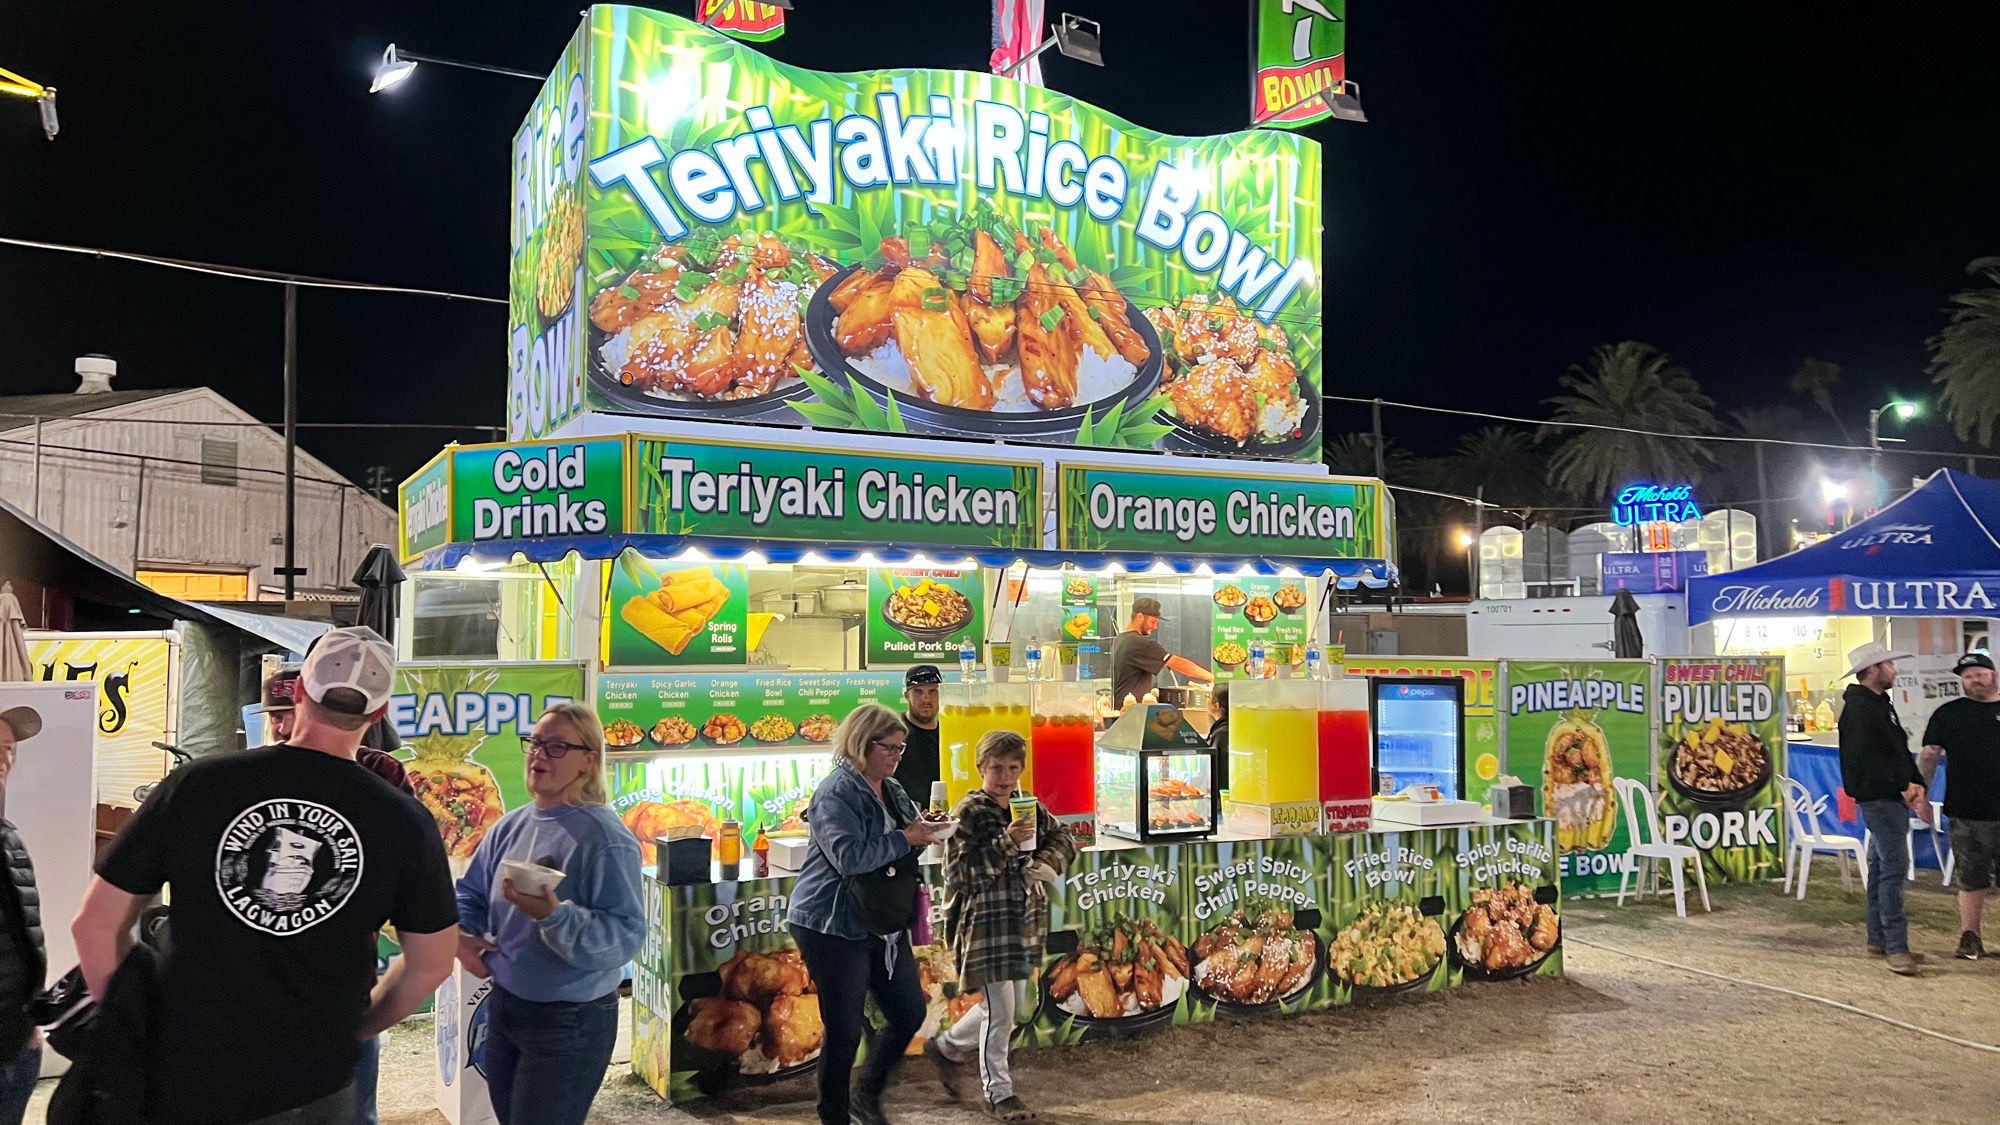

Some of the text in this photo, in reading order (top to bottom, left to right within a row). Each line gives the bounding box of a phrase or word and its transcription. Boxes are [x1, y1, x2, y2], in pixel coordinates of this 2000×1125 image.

[515, 73, 585, 254] Rice
[589, 92, 1310, 326] Teriyaki Rice Bowl
[493, 445, 586, 495] Cold
[660, 456, 1018, 527] Teriyaki Chicken
[473, 493, 607, 540] Drinks
[1089, 482, 1356, 542] Orange Chicken
[1612, 502, 1703, 526] ULTRA
[1841, 532, 1935, 549] ULTRA
[1603, 565, 1640, 575] ULTRA
[1712, 581, 1994, 612] Michelob ULTRA
[708, 622, 737, 633] Spring
[711, 634, 733, 643] Rolls
[884, 642, 916, 651] Pulled
[918, 642, 942, 651] Pork
[606, 680, 638, 689] Teriyaki
[651, 680, 697, 689] Spicy Garlic
[710, 680, 738, 689] Orange
[756, 679, 792, 687] Fried Rice
[822, 679, 840, 688] Spicy
[847, 678, 890, 687] Fresh Veggie
[1666, 664, 1768, 682] SWEET CHILI
[605, 691, 638, 700] Chicken
[658, 691, 689, 699] Chicken
[709, 690, 740, 698] Chicken
[765, 689, 783, 697] Bowl
[815, 689, 840, 697] Pepper
[860, 688, 876, 696] Bowl
[1411, 688, 1435, 697] pepsi
[1510, 679, 1645, 716] PINEAPPLE
[1664, 683, 1774, 724] PULLED
[389, 692, 575, 738] EAPPL
[609, 785, 663, 811] range
[224, 812, 264, 852] WIND
[268, 803, 290, 819] IN
[297, 804, 344, 836] YOUR
[337, 837, 358, 873] SAIL
[1665, 808, 1777, 850] PORK
[1343, 847, 1434, 878] Fried Rice
[1455, 837, 1552, 869] Spicy Garlic
[1065, 861, 1177, 893] Teriyaki
[1194, 856, 1313, 893] Sweet Spicy
[1365, 868, 1416, 889] Bowl
[1474, 858, 1542, 883] Chicken
[226, 886, 332, 931] LAGWAGON
[1077, 880, 1166, 911] Chicken
[1194, 879, 1317, 920] Chili Pepper
[705, 894, 788, 926] Oran
[710, 914, 788, 948] Chick
[632, 961, 671, 1024] REFILLS
